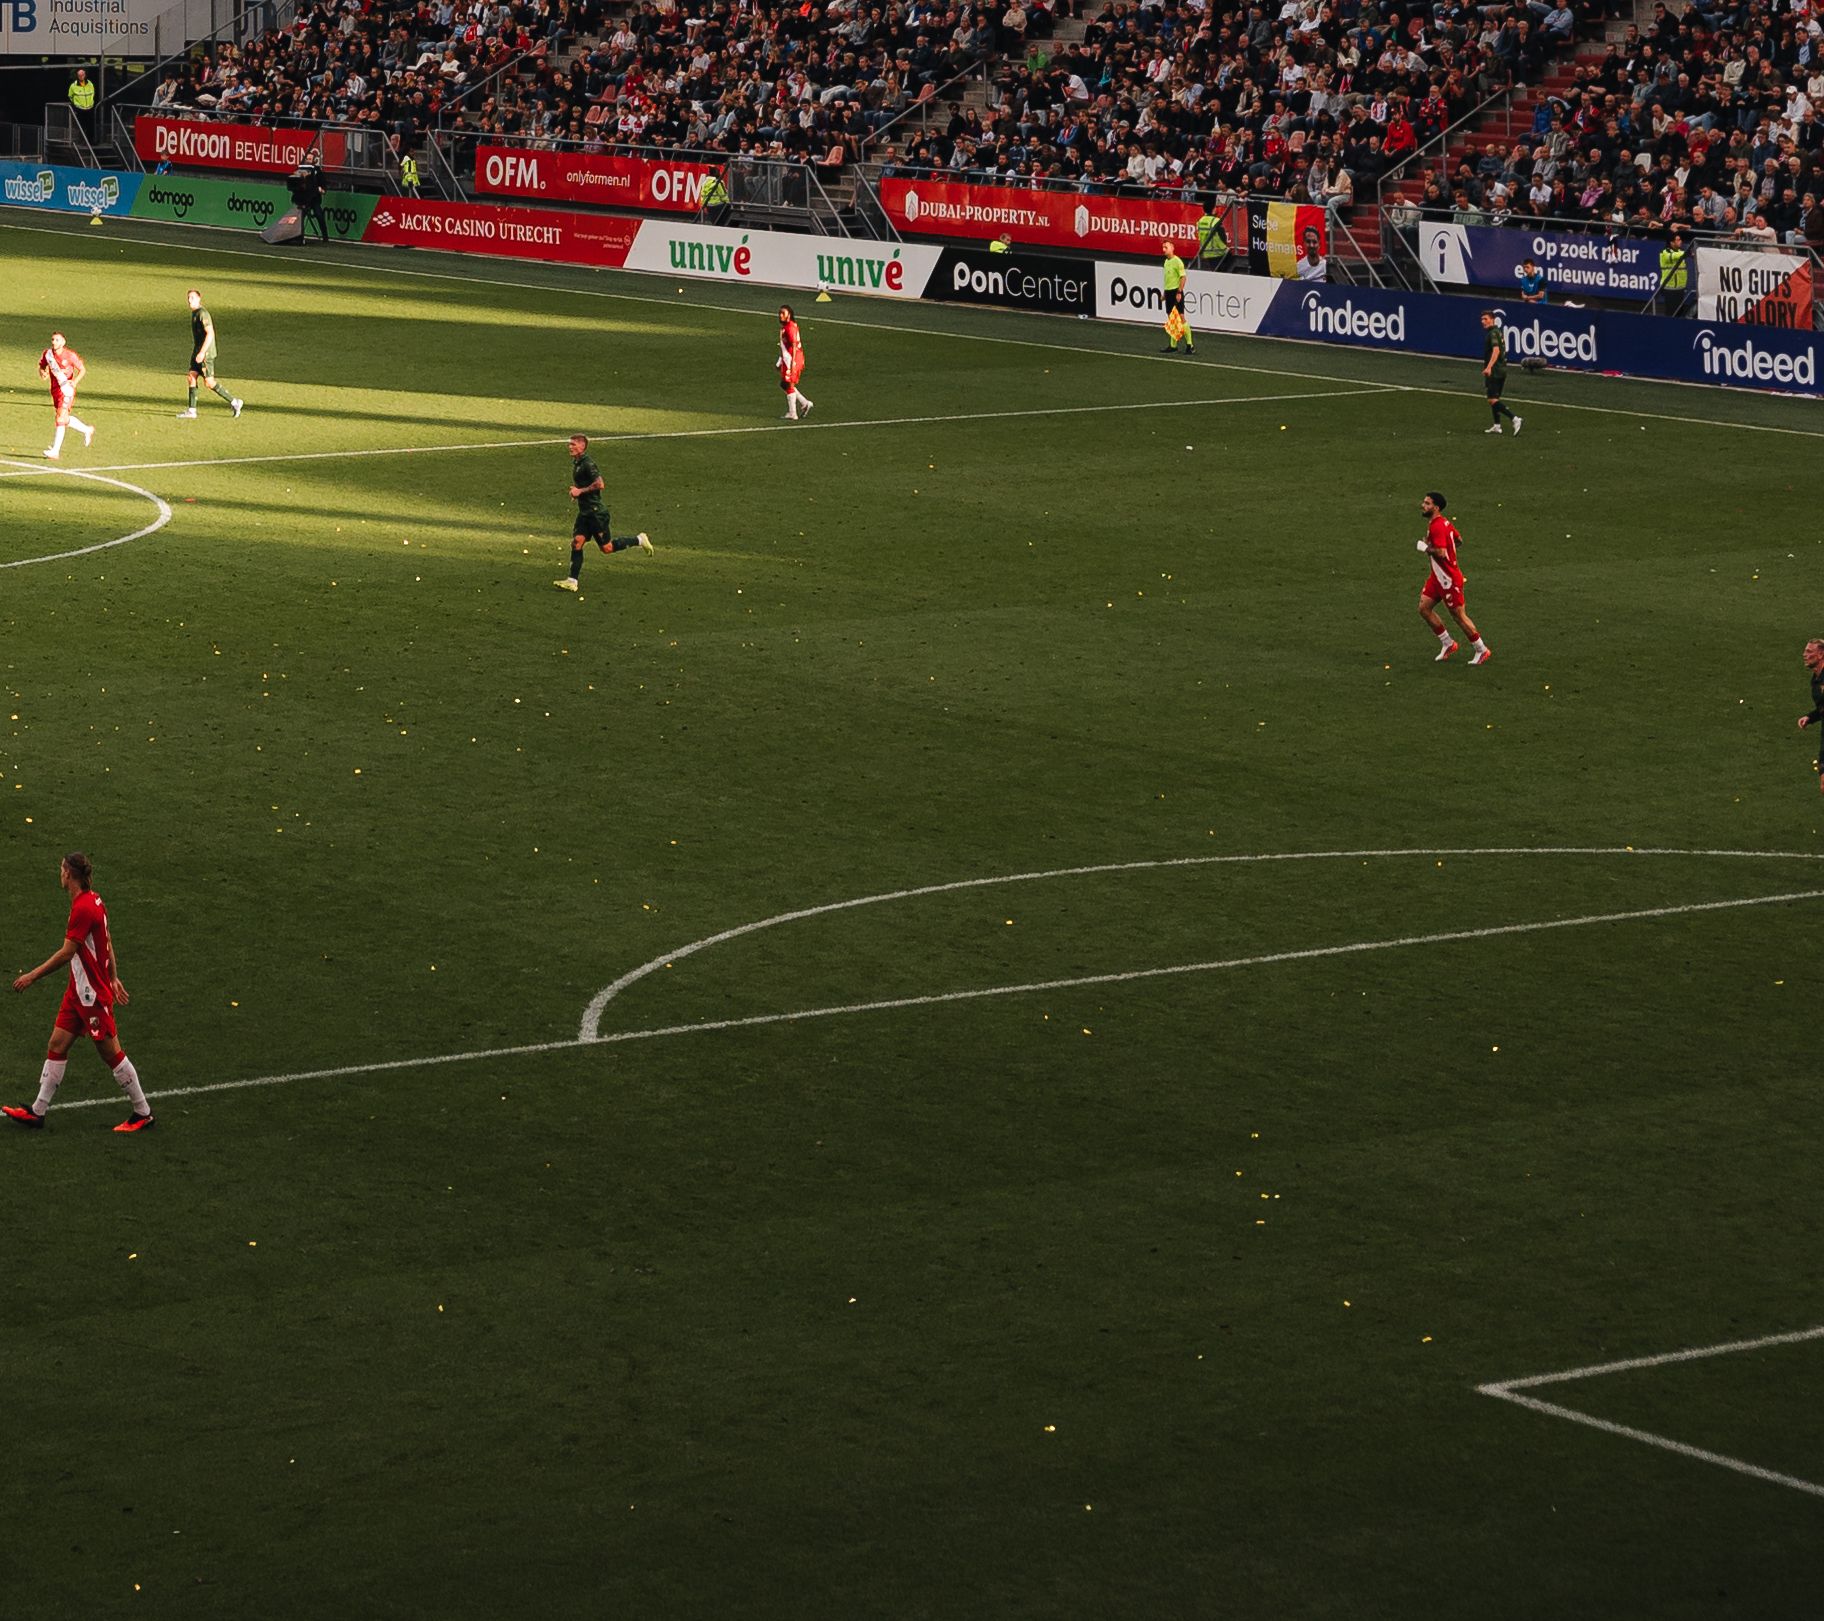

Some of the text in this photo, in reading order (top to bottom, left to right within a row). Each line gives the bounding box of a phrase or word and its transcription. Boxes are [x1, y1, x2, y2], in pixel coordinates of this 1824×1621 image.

[49, 18, 149, 37] Acquisitions
[566, 169, 630, 189] onlyformen.nl
[149, 185, 194, 218] domogo
[227, 192, 274, 226] domogo
[919, 201, 1051, 227] DUBAI-PROPERTY.NL
[399, 211, 442, 233] JACK'S
[445, 217, 496, 238] CASINO
[499, 222, 563, 245] UTRECHT
[1252, 214, 1279, 231] Siebe
[1252, 236, 1304, 255] Horemans
[1532, 236, 1557, 260] Op
[1561, 239, 1598, 261] zoek
[953, 261, 1088, 303] PonCenter
[1548, 263, 1605, 285] nieuwe
[1609, 267, 1659, 291] baan?
[1719, 266, 1792, 299] NO GUTS
[1110, 276, 1252, 320] Ponenter
[1716, 294, 1797, 329] NO GLORY
[1308, 296, 1405, 341] indeed
[1701, 337, 1815, 385] indeed
